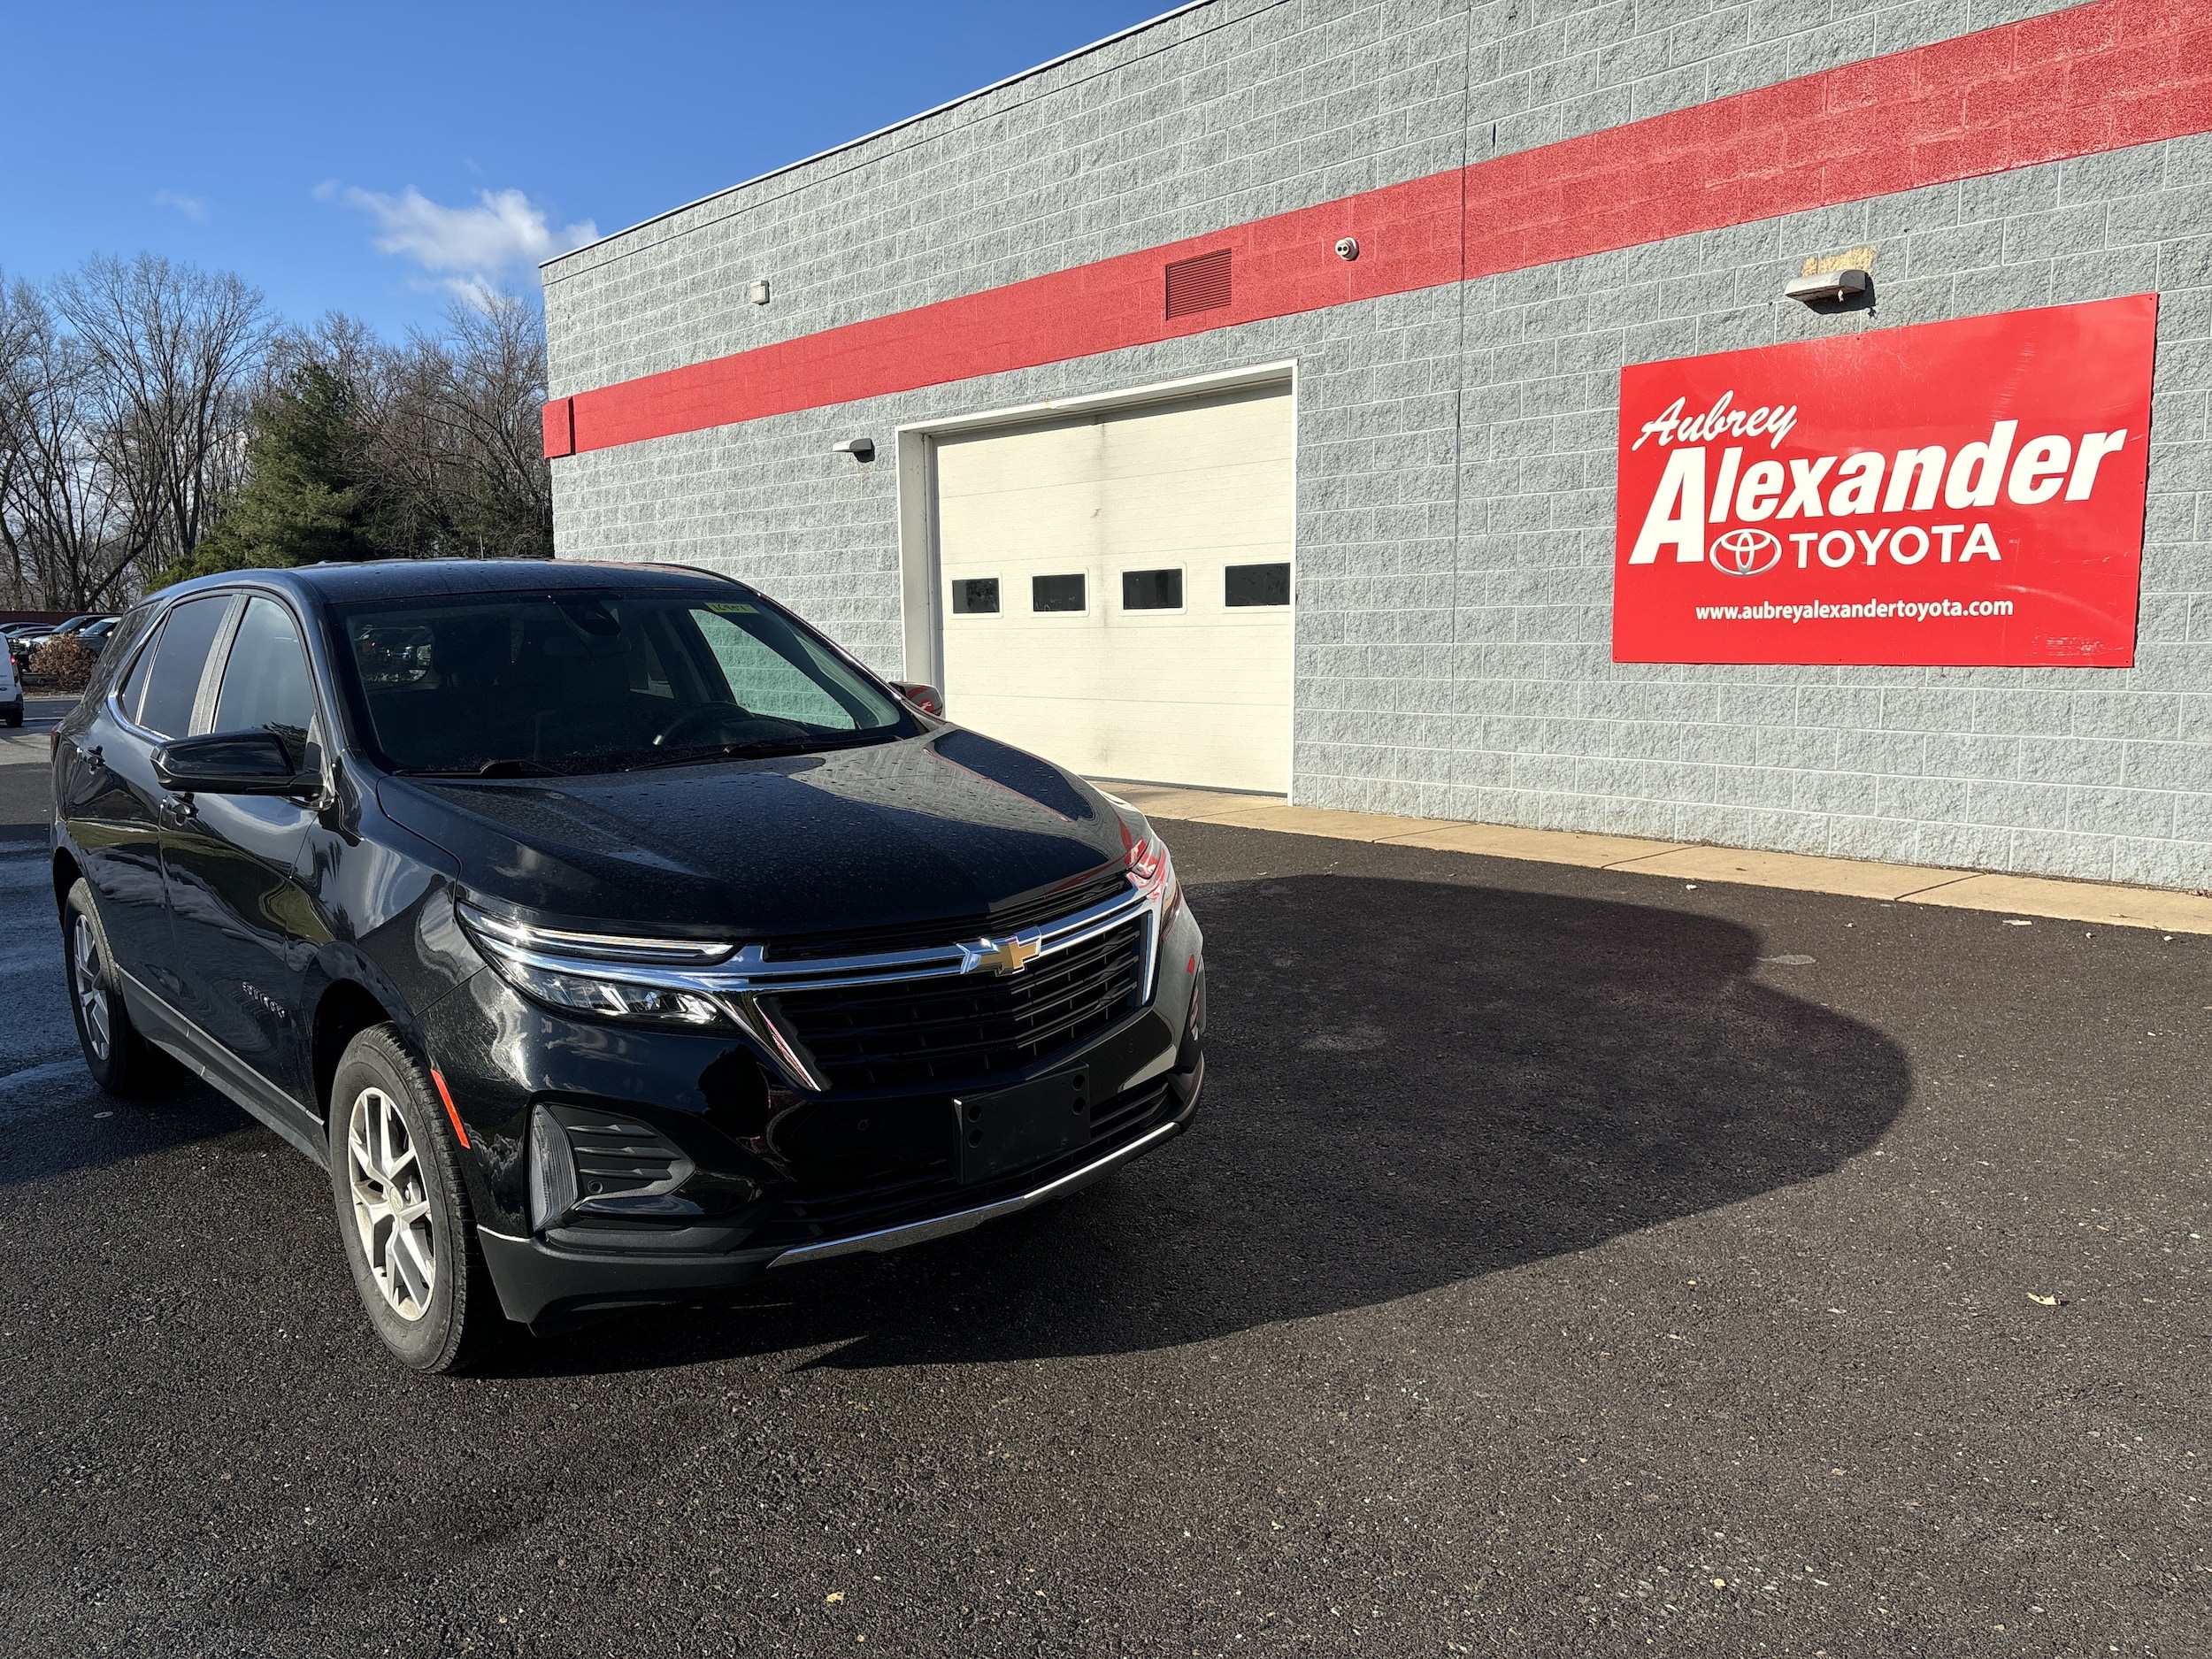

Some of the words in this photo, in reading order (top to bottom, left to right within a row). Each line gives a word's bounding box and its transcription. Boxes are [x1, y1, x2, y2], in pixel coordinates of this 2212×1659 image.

[1632, 389, 1798, 450] Aubrey
[1628, 419, 2128, 565] Alexander
[1789, 522, 2002, 569] TOYOTA
[1695, 598, 2015, 624] www.aubreyalexandertoyota.com
